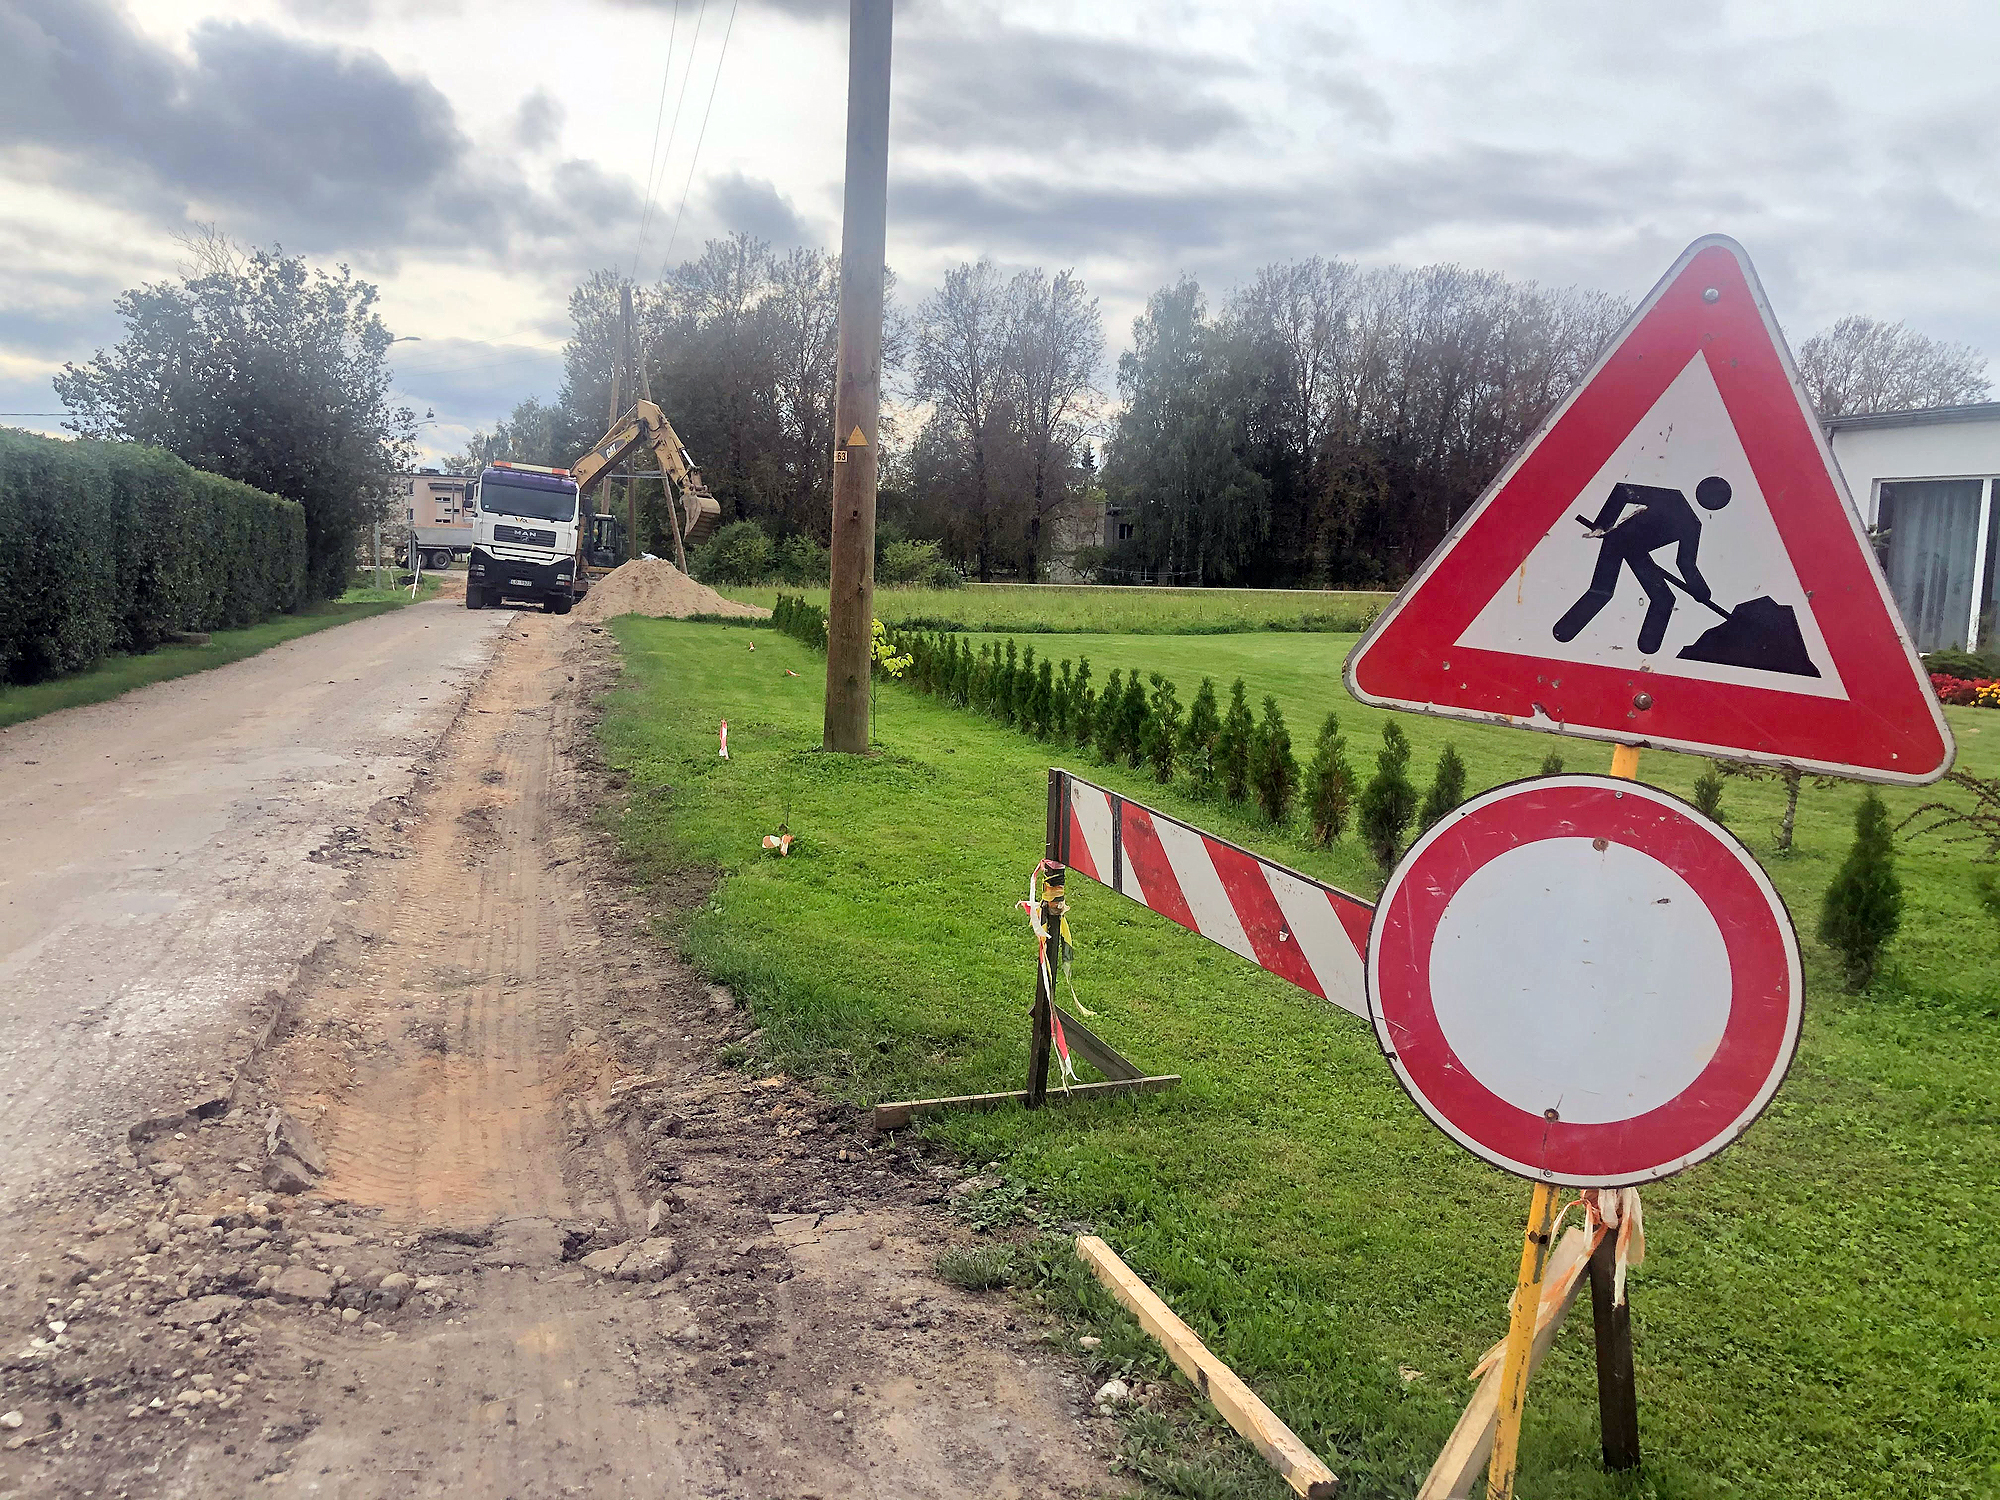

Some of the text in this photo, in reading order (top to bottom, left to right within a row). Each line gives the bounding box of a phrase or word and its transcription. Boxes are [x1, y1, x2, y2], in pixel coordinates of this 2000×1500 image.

[605, 442, 616, 459] CAT
[837, 452, 846, 461] 63
[514, 529, 537, 537] MAN
